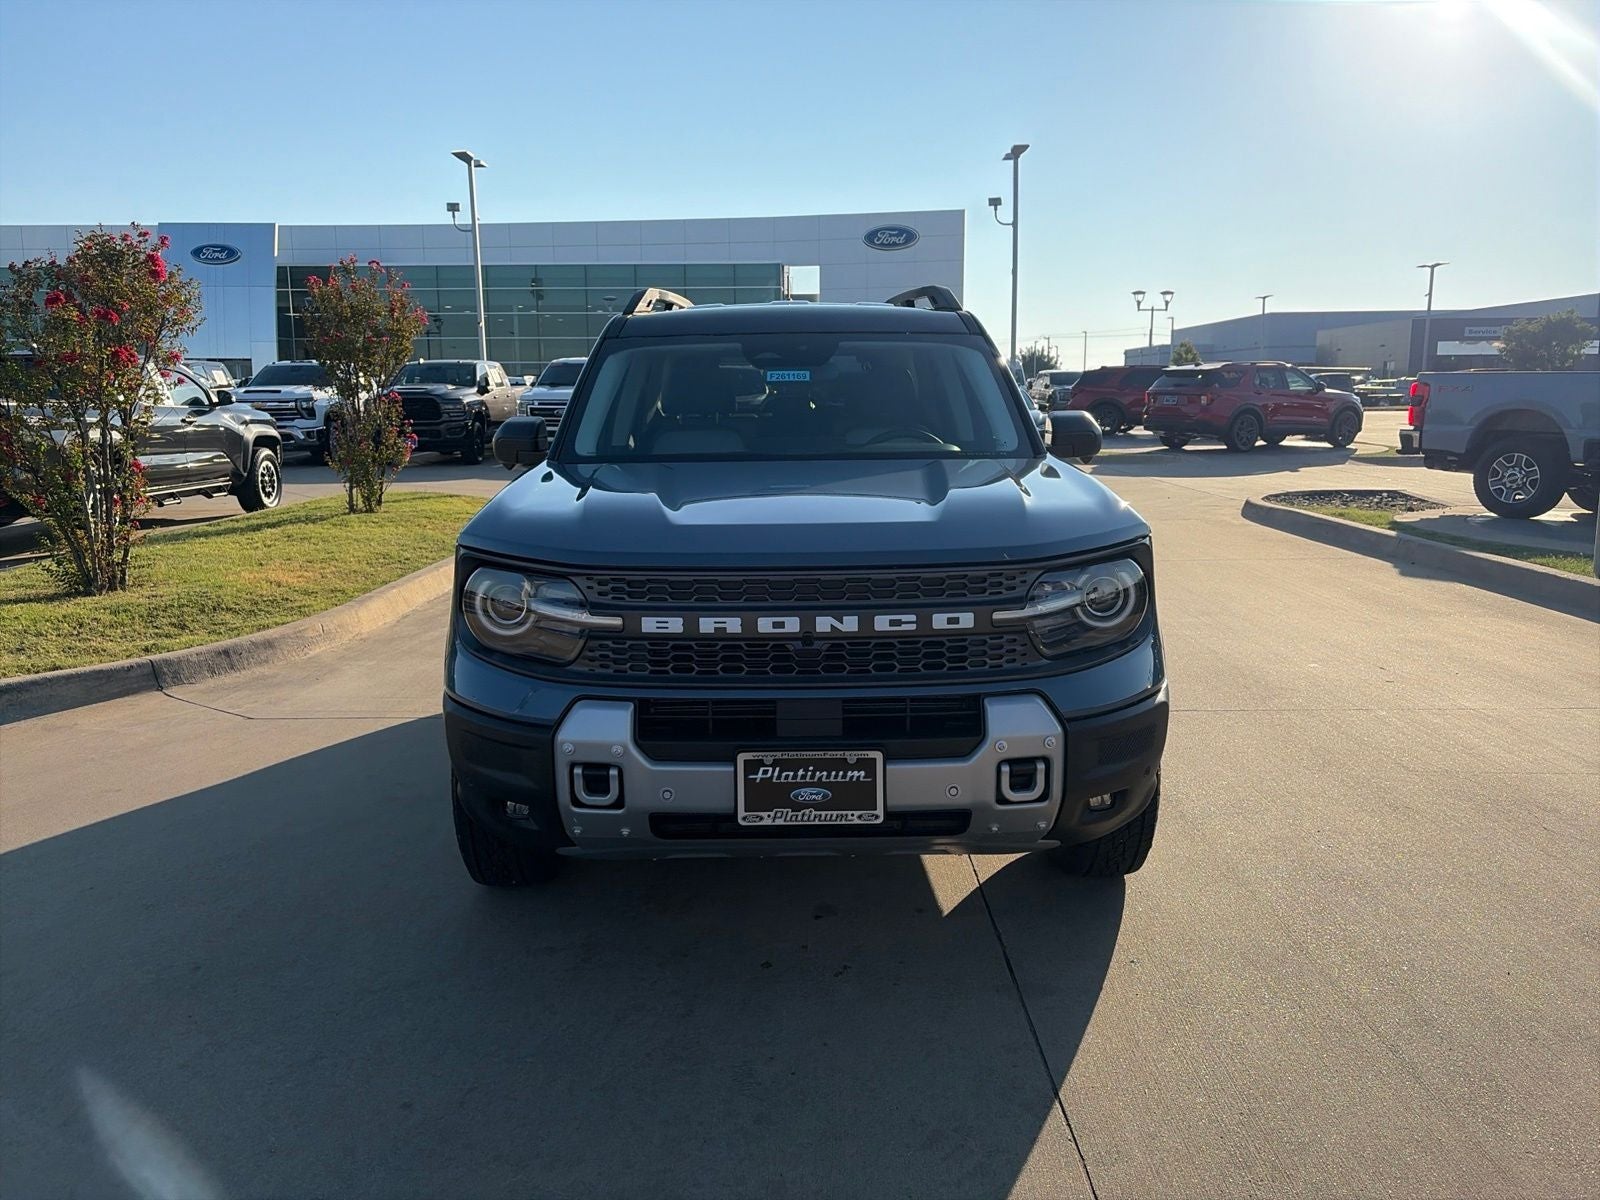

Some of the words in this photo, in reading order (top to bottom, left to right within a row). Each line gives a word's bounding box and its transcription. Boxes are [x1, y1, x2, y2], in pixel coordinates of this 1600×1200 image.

[874, 230, 906, 244] Ford
[199, 246, 228, 259] Ford
[641, 611, 975, 633] BRONCO
[747, 766, 873, 783] Platinum
[798, 789, 825, 801] Ford
[772, 808, 851, 823] Platinum
